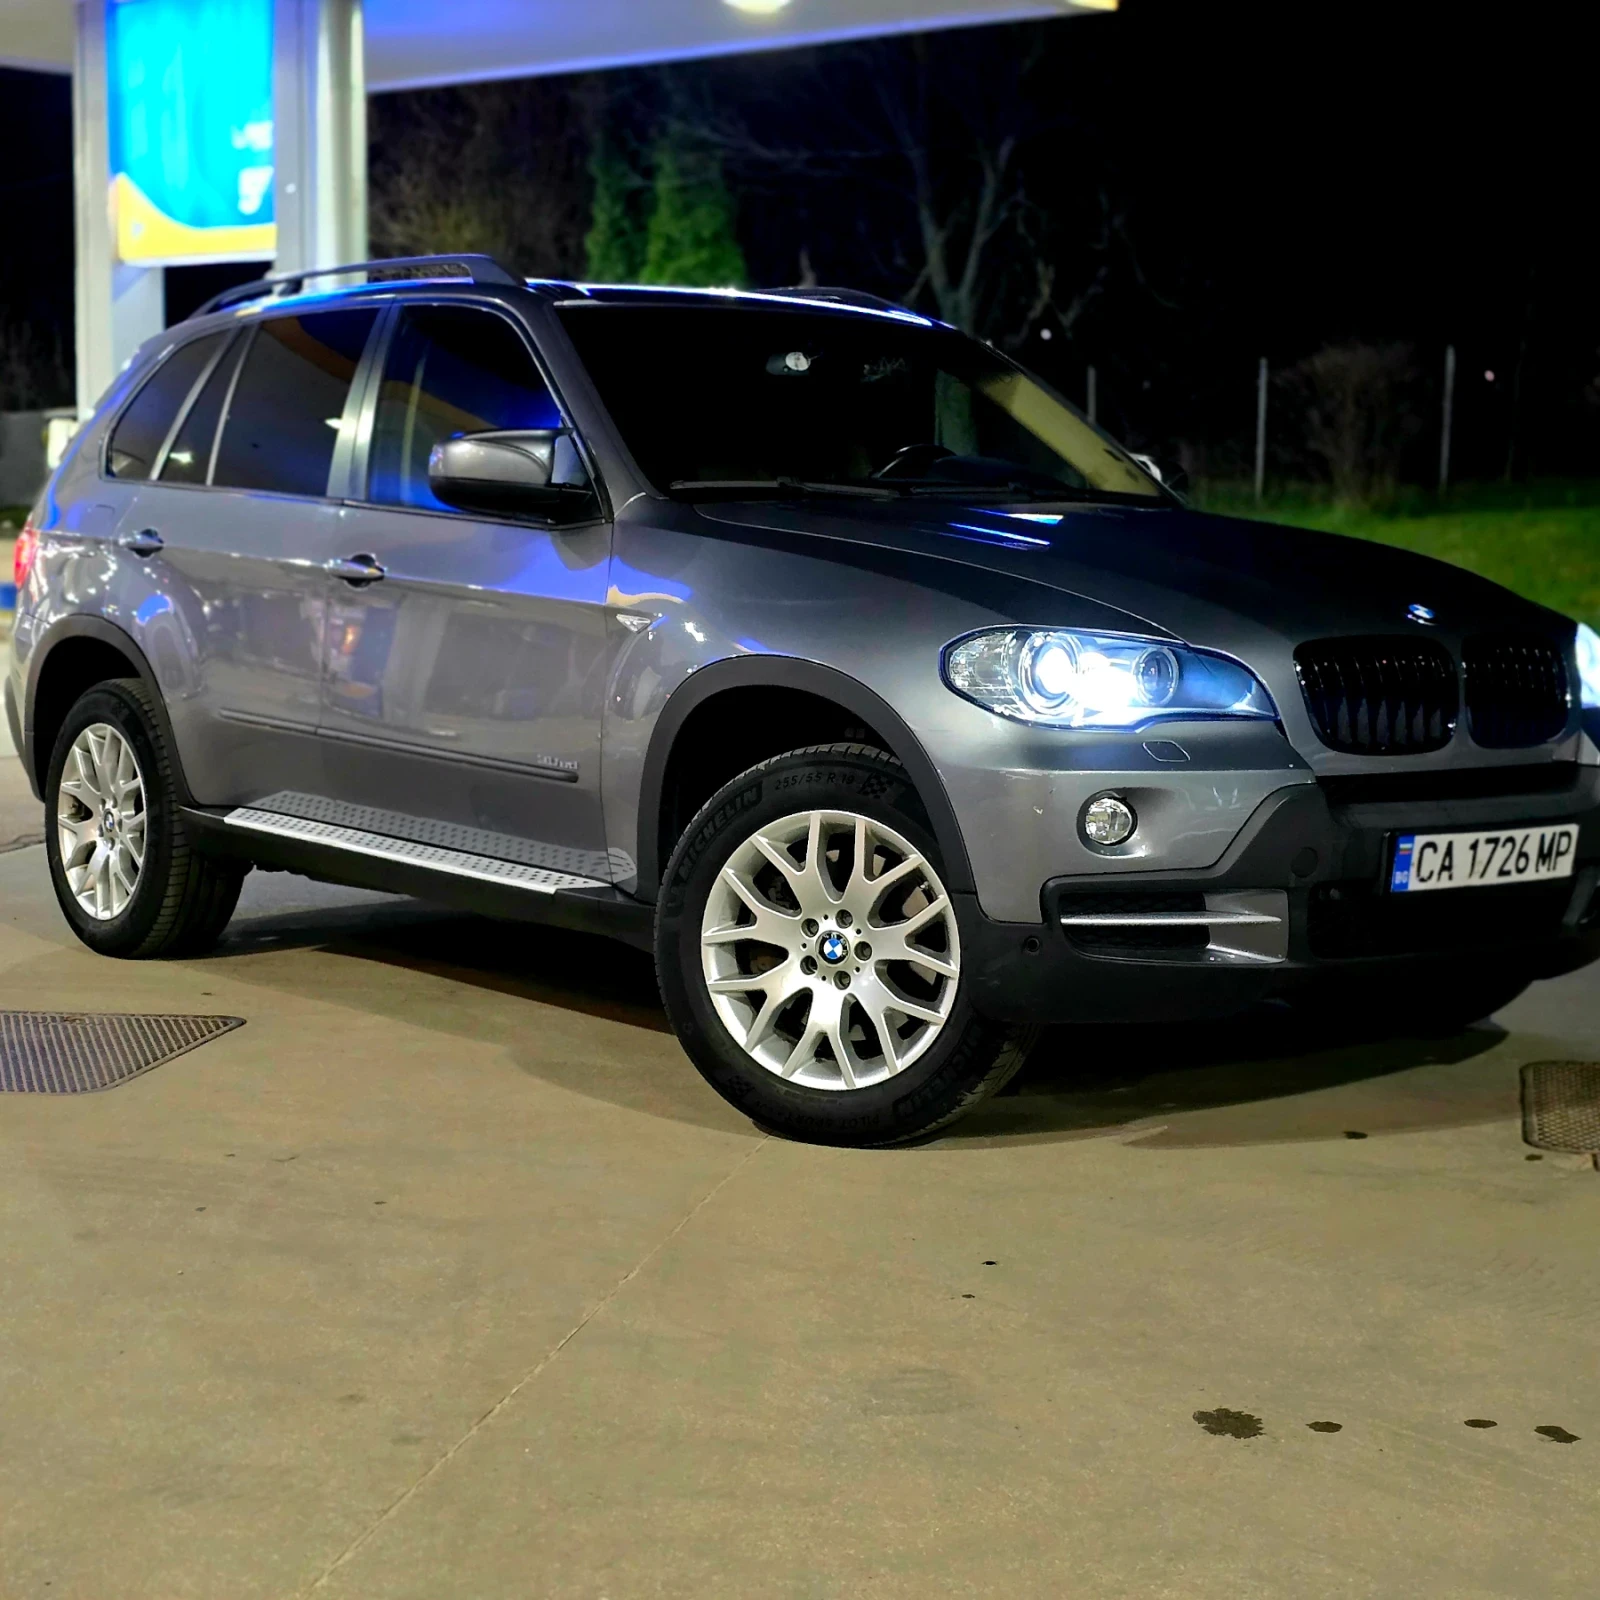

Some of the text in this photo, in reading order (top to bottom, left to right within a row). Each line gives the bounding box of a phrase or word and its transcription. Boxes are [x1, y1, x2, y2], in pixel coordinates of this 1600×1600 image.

[774, 772, 856, 790] 255/55 R 19
[677, 785, 760, 882] MICHELIN
[1416, 829, 1573, 883] CA 1726 MP
[1394, 870, 1409, 885] BG
